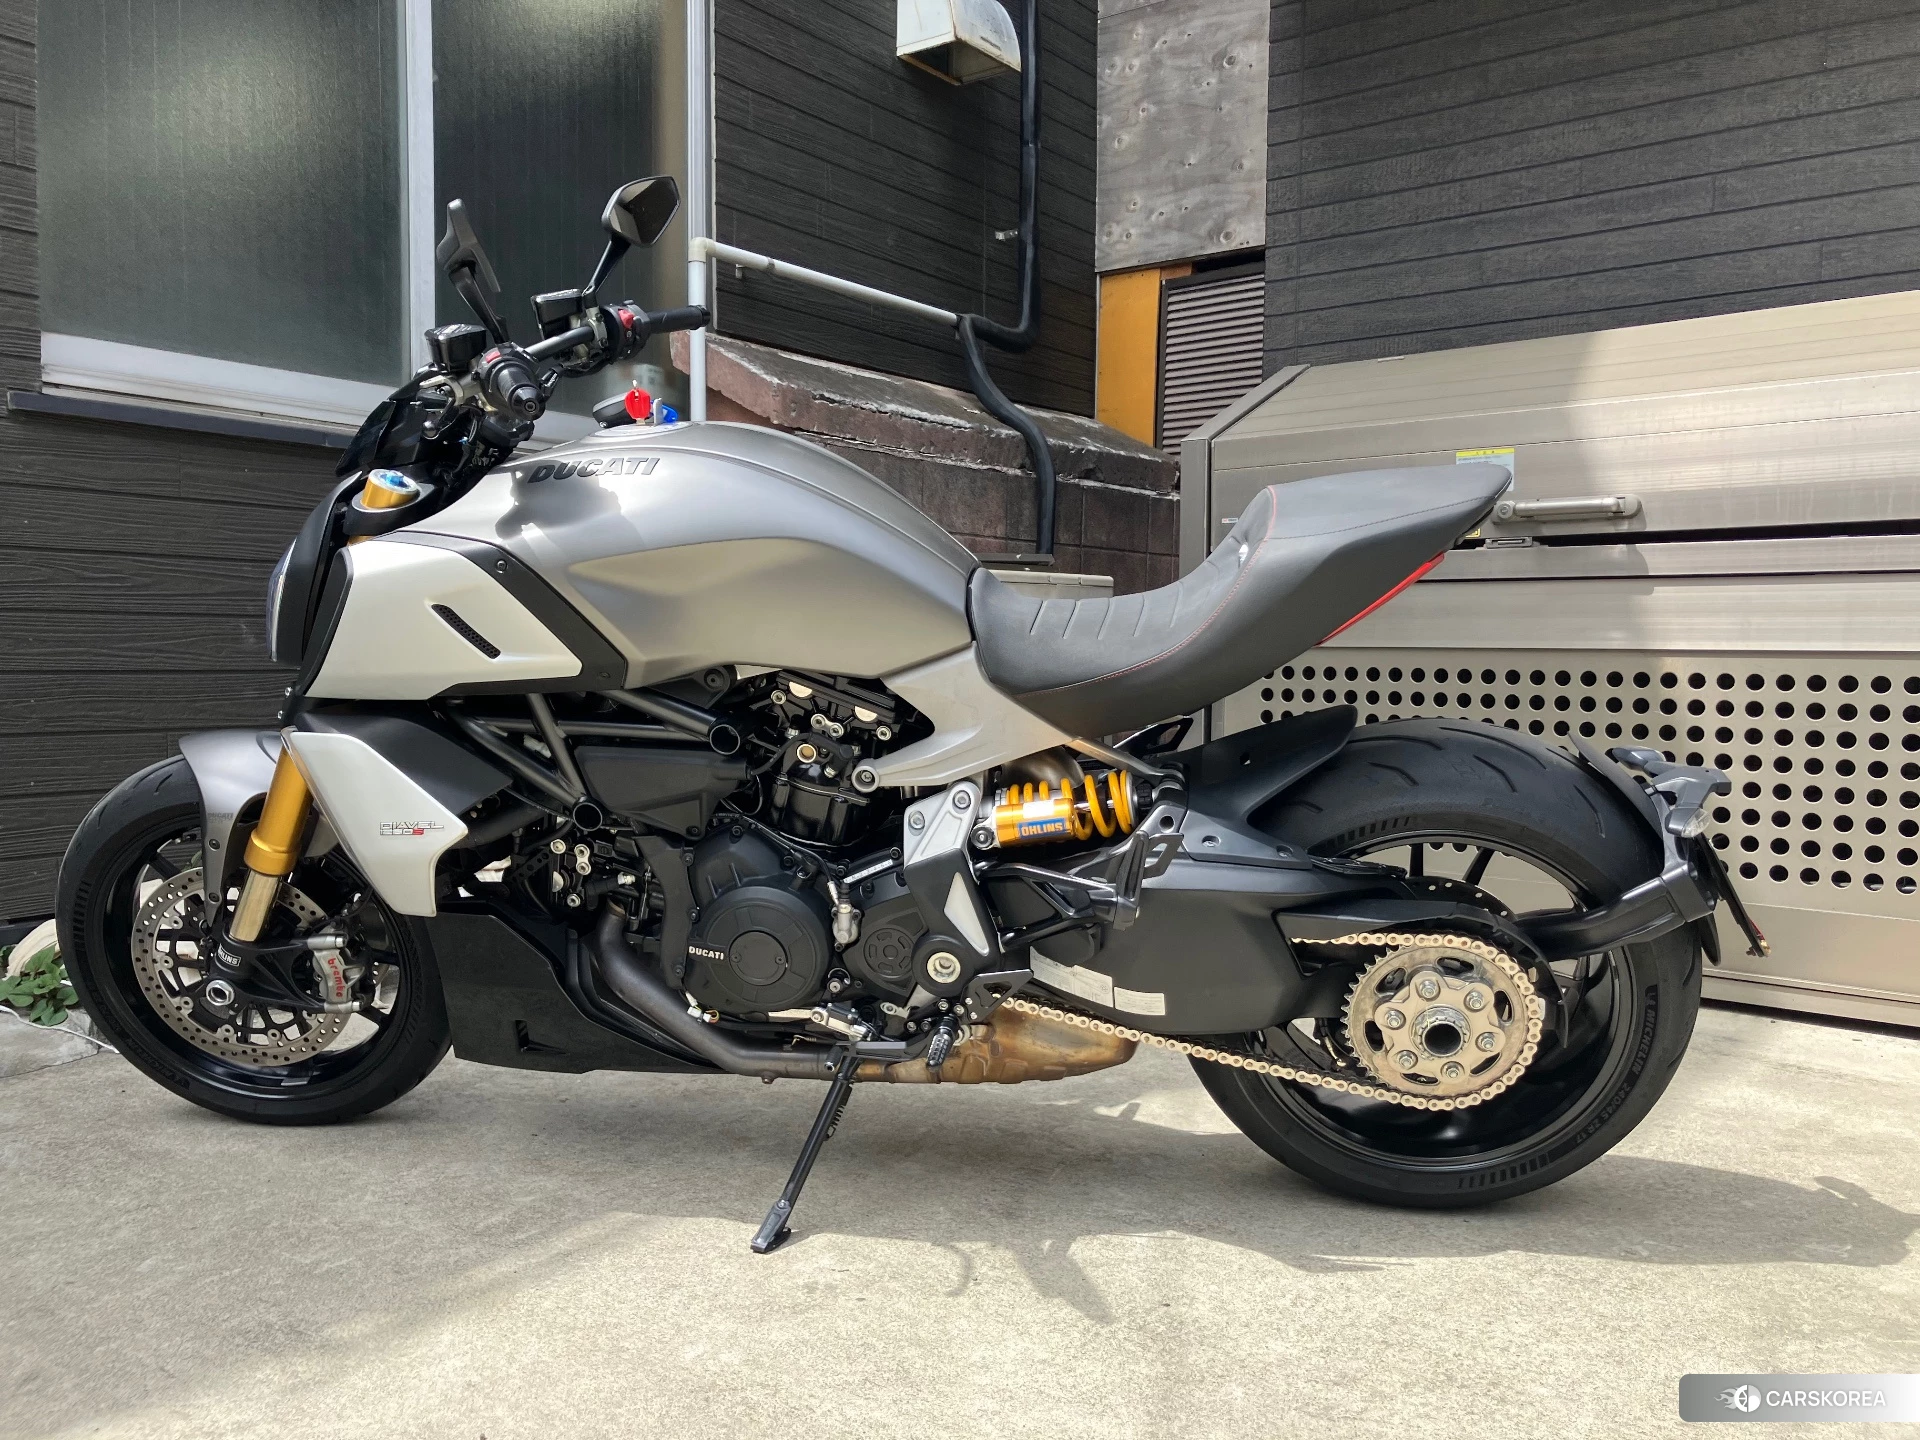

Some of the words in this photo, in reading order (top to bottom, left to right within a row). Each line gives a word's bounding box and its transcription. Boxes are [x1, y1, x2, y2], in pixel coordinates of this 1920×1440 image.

[527, 457, 661, 484] DUCATI
[688, 945, 725, 961] DUCATI
[327, 957, 344, 999] brembo
[1631, 1009, 1656, 1075] MICHELIN
